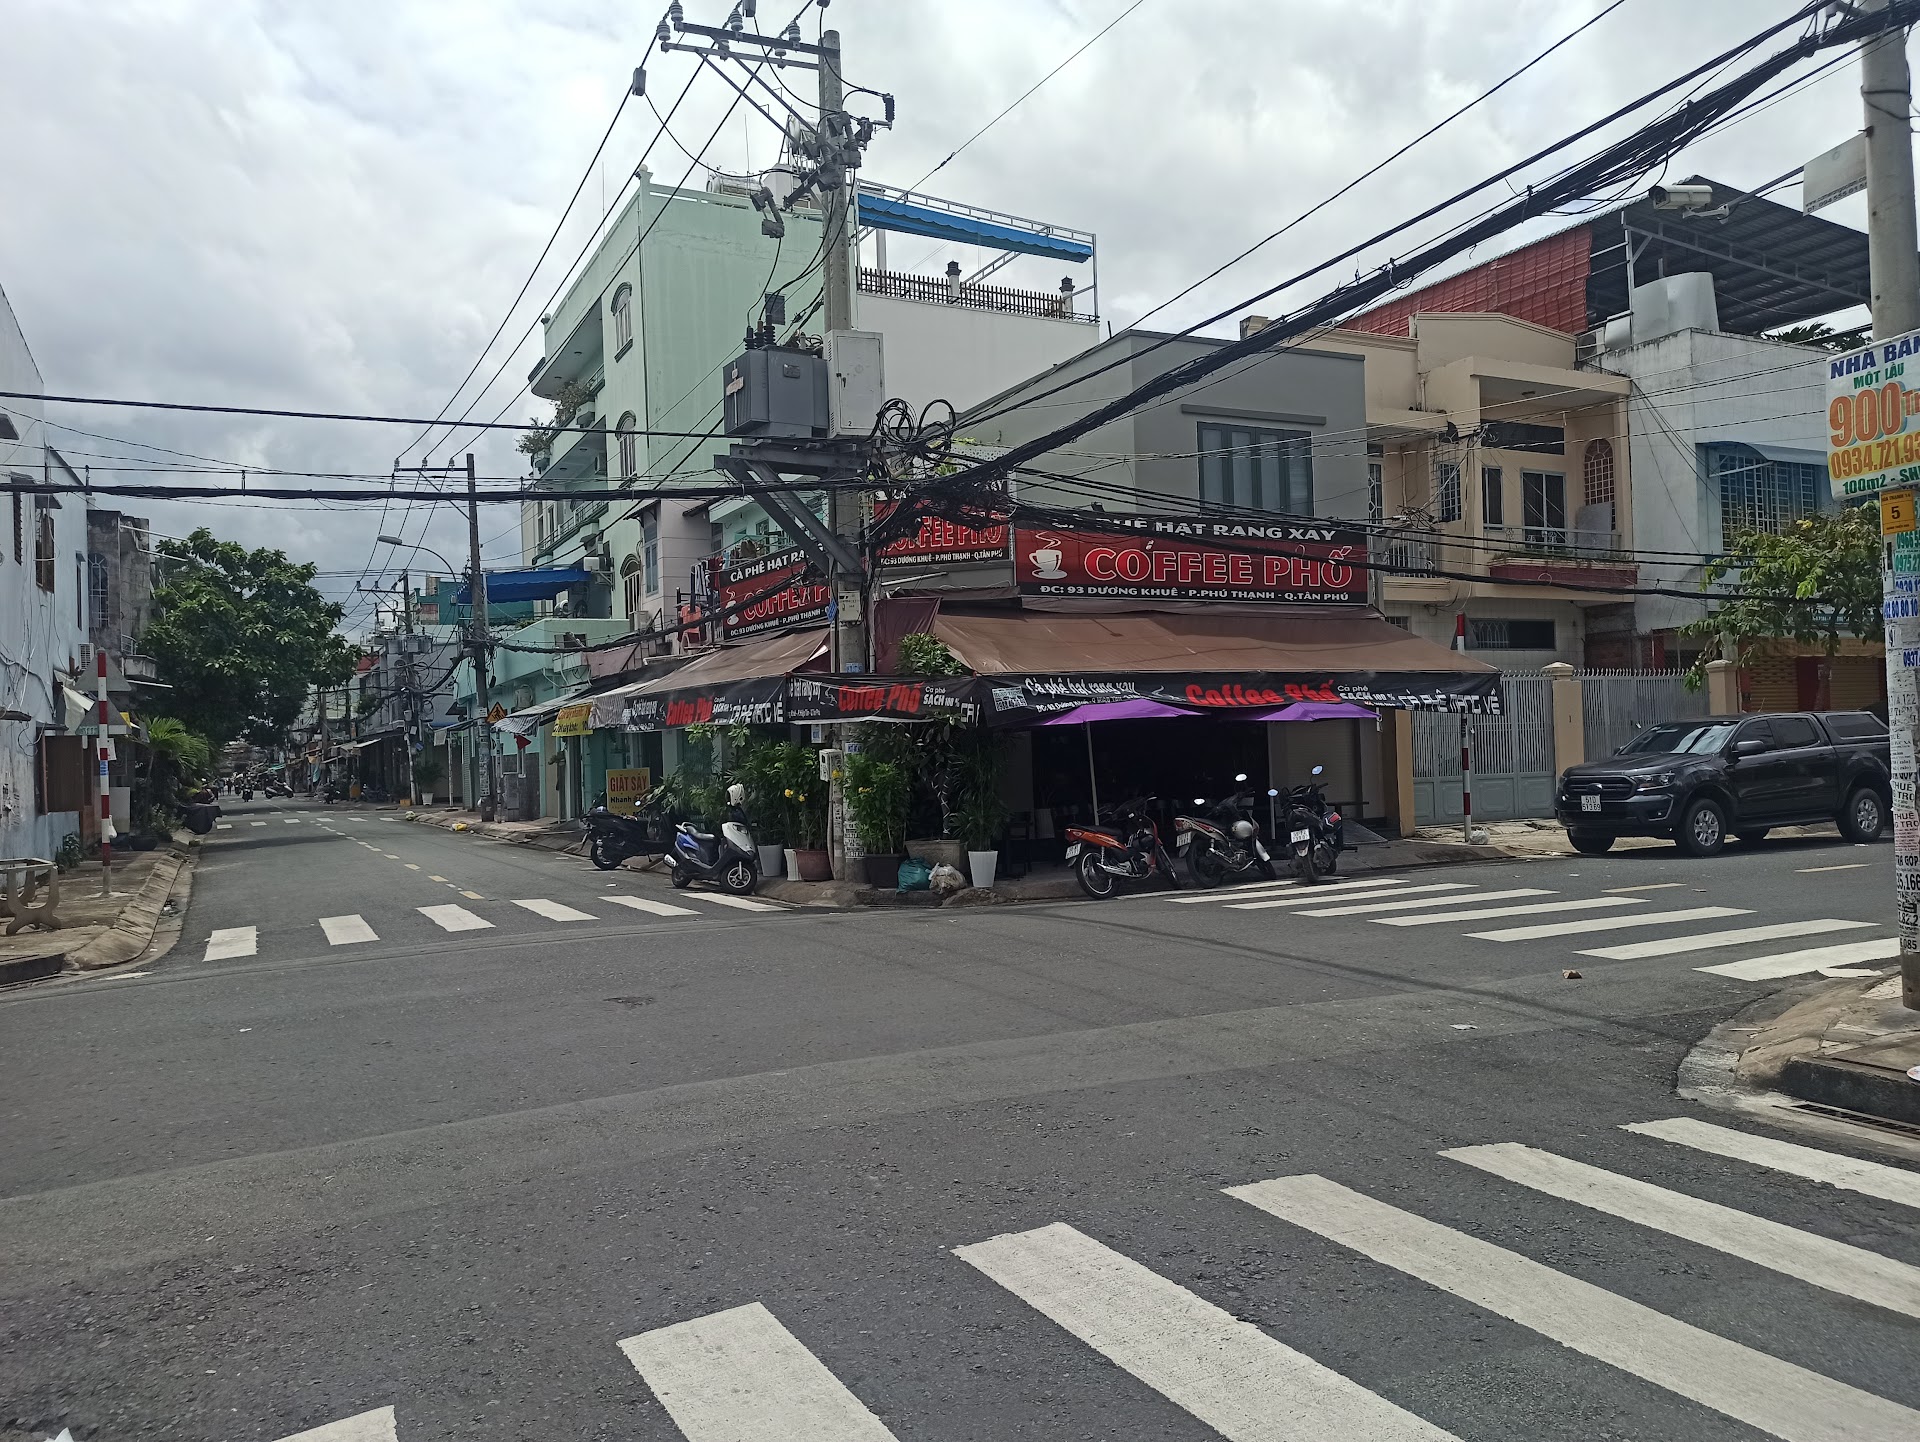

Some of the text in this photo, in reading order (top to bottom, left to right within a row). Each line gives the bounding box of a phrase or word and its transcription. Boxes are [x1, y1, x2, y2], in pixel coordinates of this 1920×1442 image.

[1853, 369, 1881, 389] MỘT
[1829, 381, 1907, 448] 900
[1842, 473, 1888, 495] 100m2
[1891, 505, 1901, 520] 5
[1155, 521, 1206, 536] HẠT
[1213, 524, 1283, 539] RANG
[1288, 528, 1336, 541] XAY
[730, 568, 744, 582] CÀ
[745, 559, 766, 578] PHÊ
[767, 555, 789, 571] HẠT
[1264, 545, 1353, 588] PHỐ
[1087, 585, 1138, 595] DƯƠNG
[1141, 587, 1178, 596] KHUÊ
[1189, 588, 1228, 598] P.PHÚ
[1230, 590, 1275, 600] THẠNH
[1284, 590, 1321, 601] Q.TÂN
[1323, 591, 1349, 601] PHÚ
[1185, 684, 1285, 706] Coffee
[1337, 684, 1350, 692] Cà
